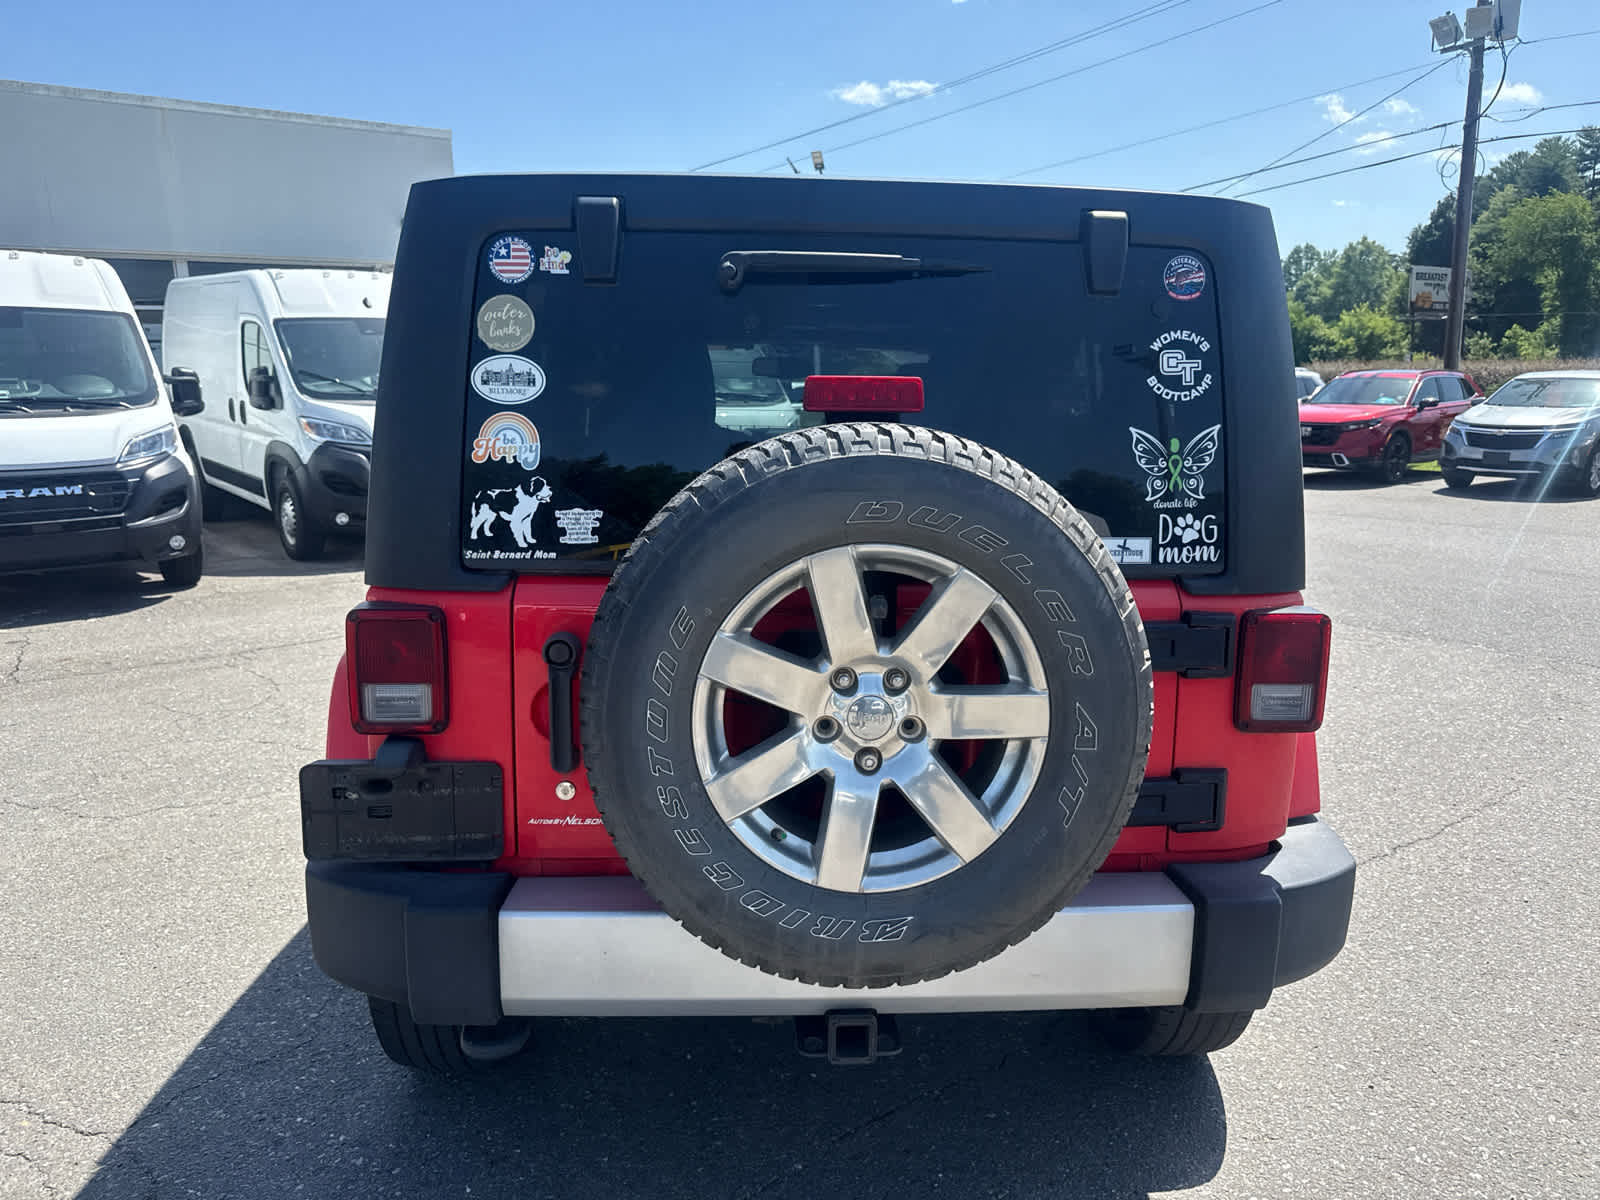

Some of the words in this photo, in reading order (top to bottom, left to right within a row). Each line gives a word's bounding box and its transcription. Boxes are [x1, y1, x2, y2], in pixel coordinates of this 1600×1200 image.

[1415, 272, 1448, 281] BREAKFAST
[484, 303, 527, 321] outer
[489, 320, 522, 337] banks
[1149, 329, 1211, 352] WOMEN'S
[489, 387, 527, 395] BILTMORE
[1146, 373, 1213, 401] BOOTCAMP
[503, 433, 516, 444] be
[472, 438, 540, 470] Happy
[0, 485, 83, 499] RAM
[1153, 499, 1183, 509] donate
[1184, 498, 1198, 508] life
[465, 550, 491, 559] Saint
[493, 550, 532, 559] Bernard
[534, 550, 557, 559] Mom
[1158, 545, 1220, 564] mom
[846, 501, 1094, 676] DUELER
[1058, 702, 1098, 829] A/T
[646, 606, 914, 942] BRIDGESTONE
